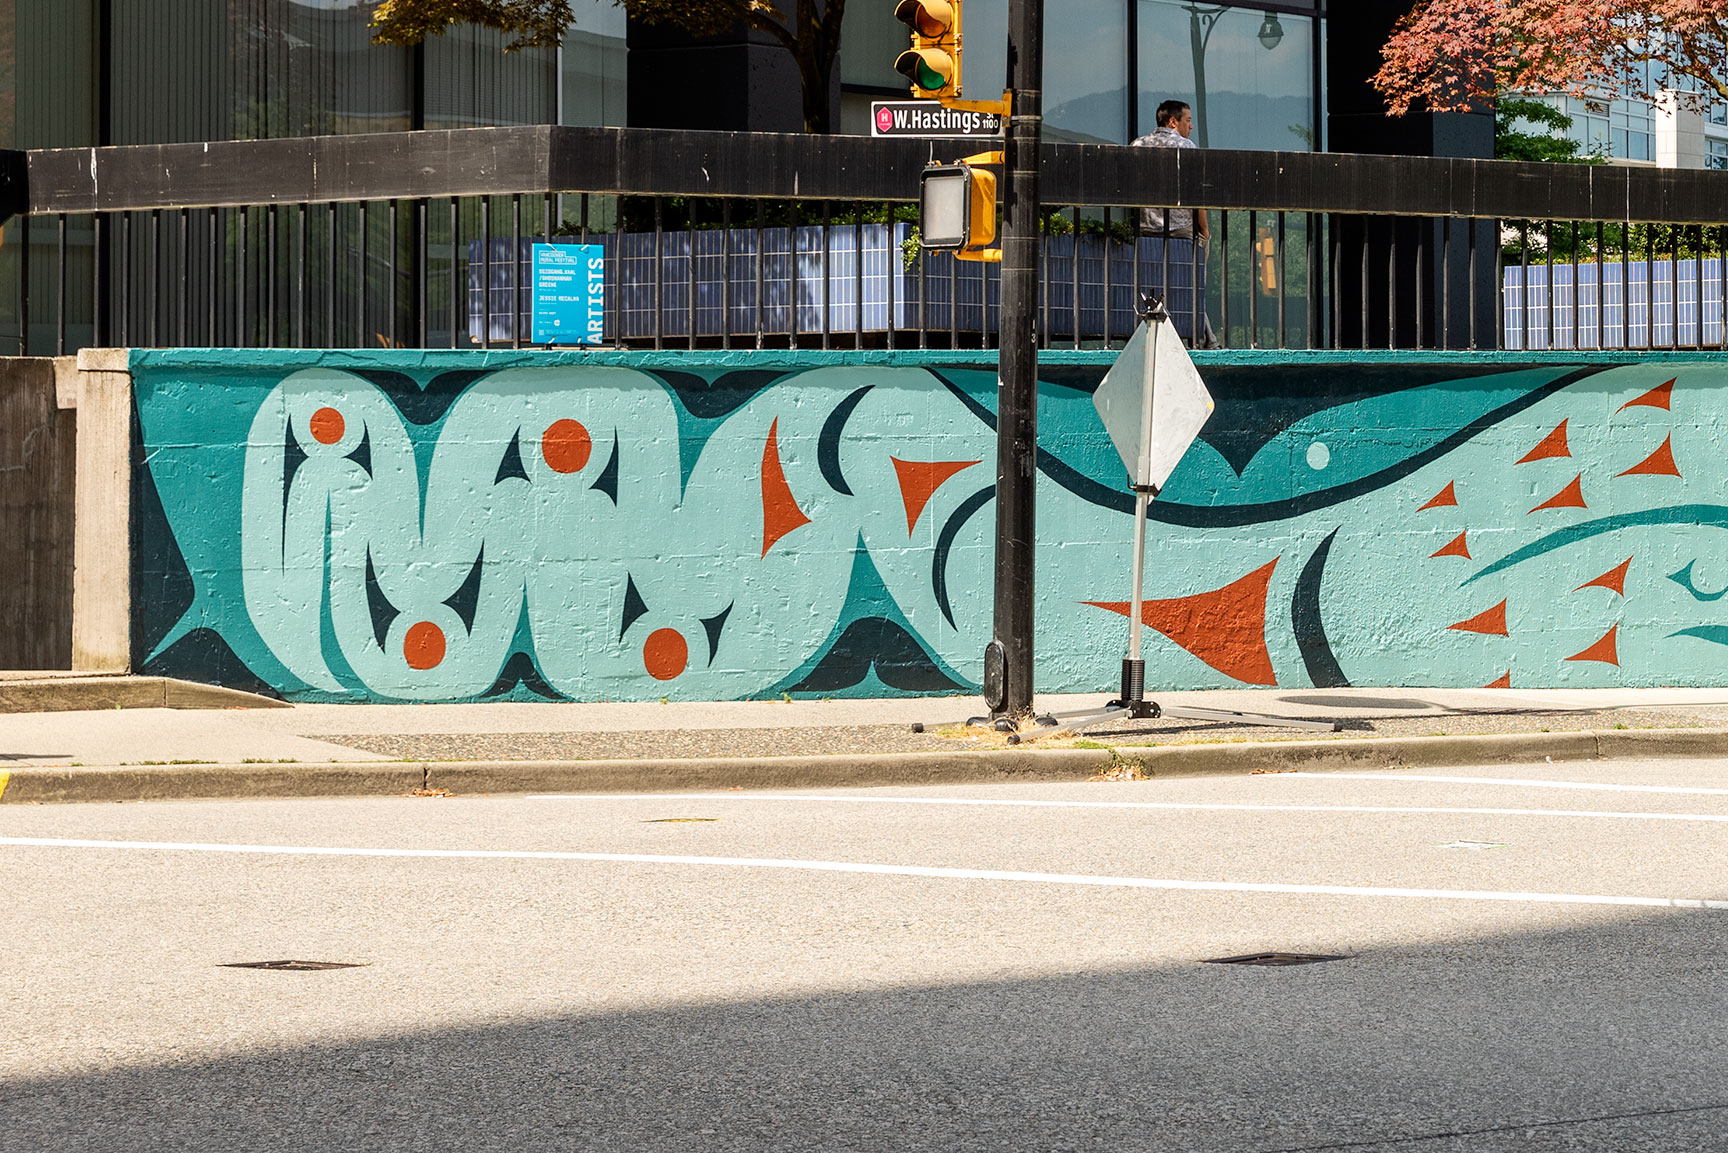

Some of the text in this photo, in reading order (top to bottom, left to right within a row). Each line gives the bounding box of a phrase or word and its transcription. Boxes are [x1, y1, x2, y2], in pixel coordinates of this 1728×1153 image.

[893, 108, 980, 134] W.Hastings
[982, 119, 999, 129] 1100
[587, 257, 604, 344] ARTISTS
